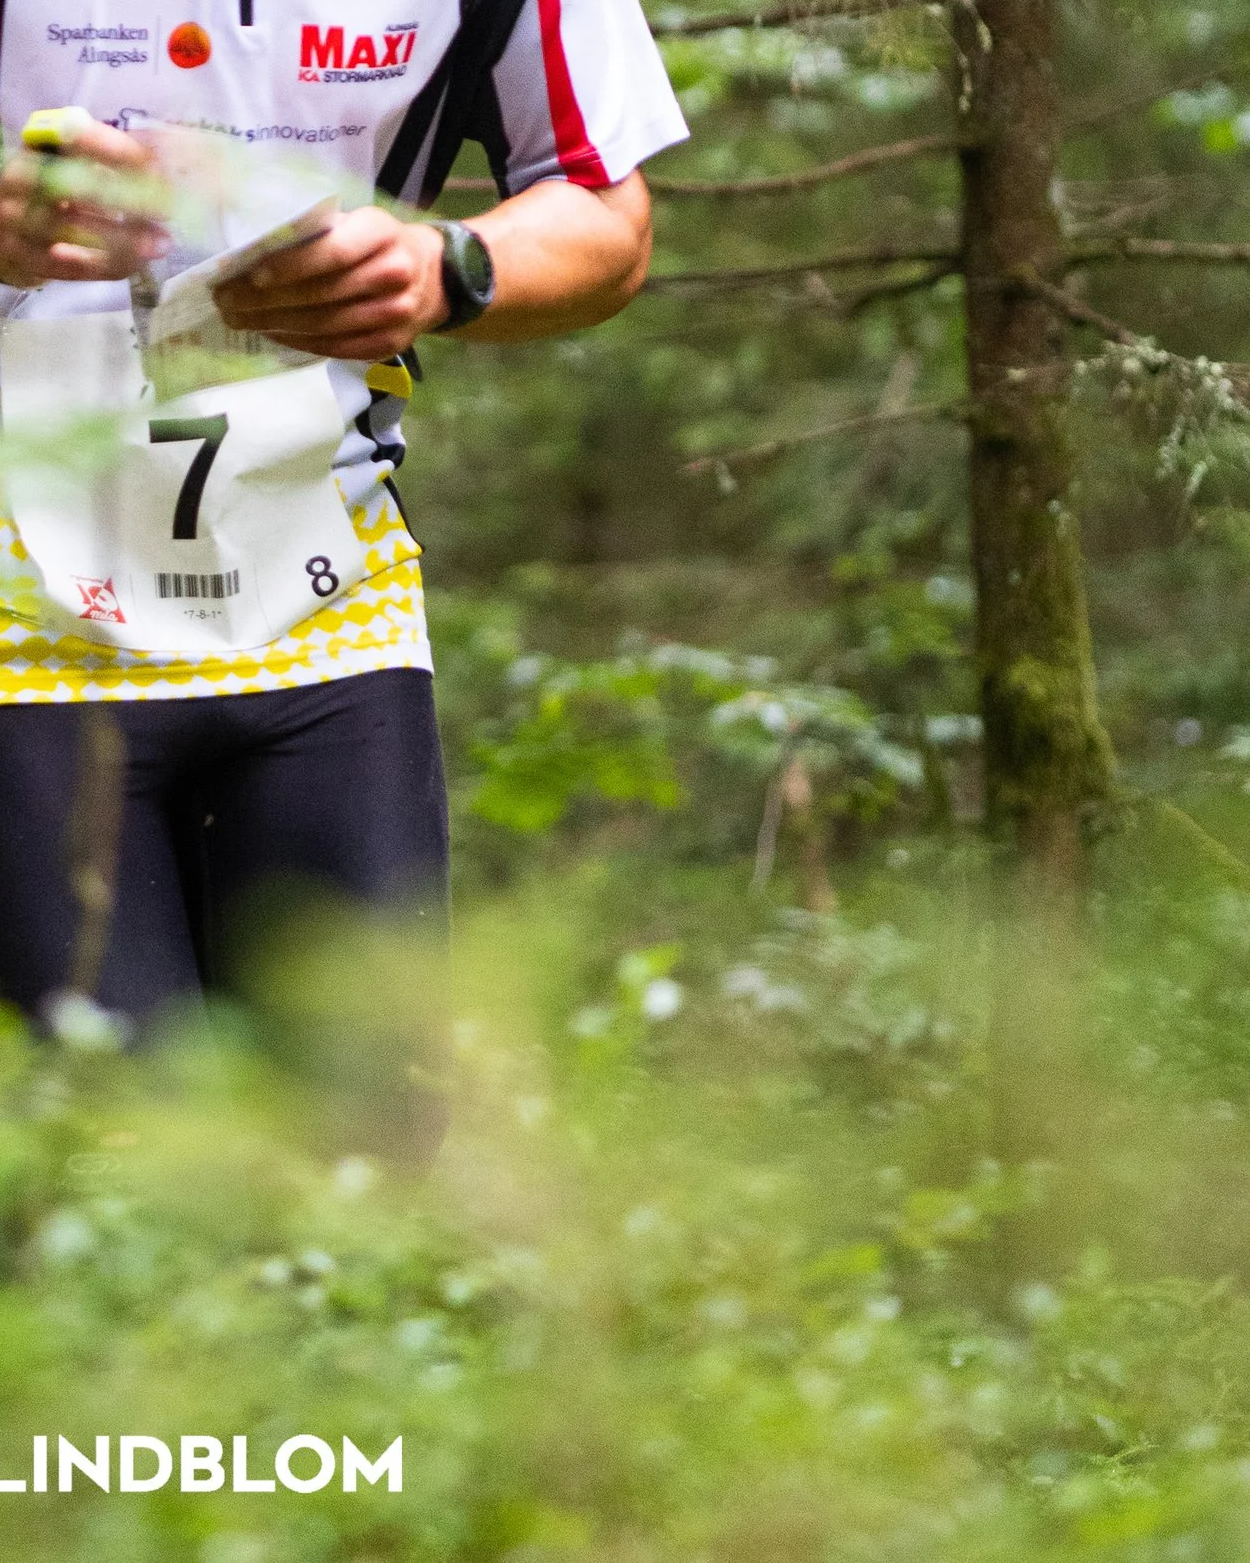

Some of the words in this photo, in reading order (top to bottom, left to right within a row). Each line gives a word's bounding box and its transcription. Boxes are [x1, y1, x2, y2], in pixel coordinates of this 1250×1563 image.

[47, 23, 148, 45] Sparbanken
[300, 24, 417, 69] MAXI
[149, 413, 229, 540] 7
[305, 555, 340, 598] 8
